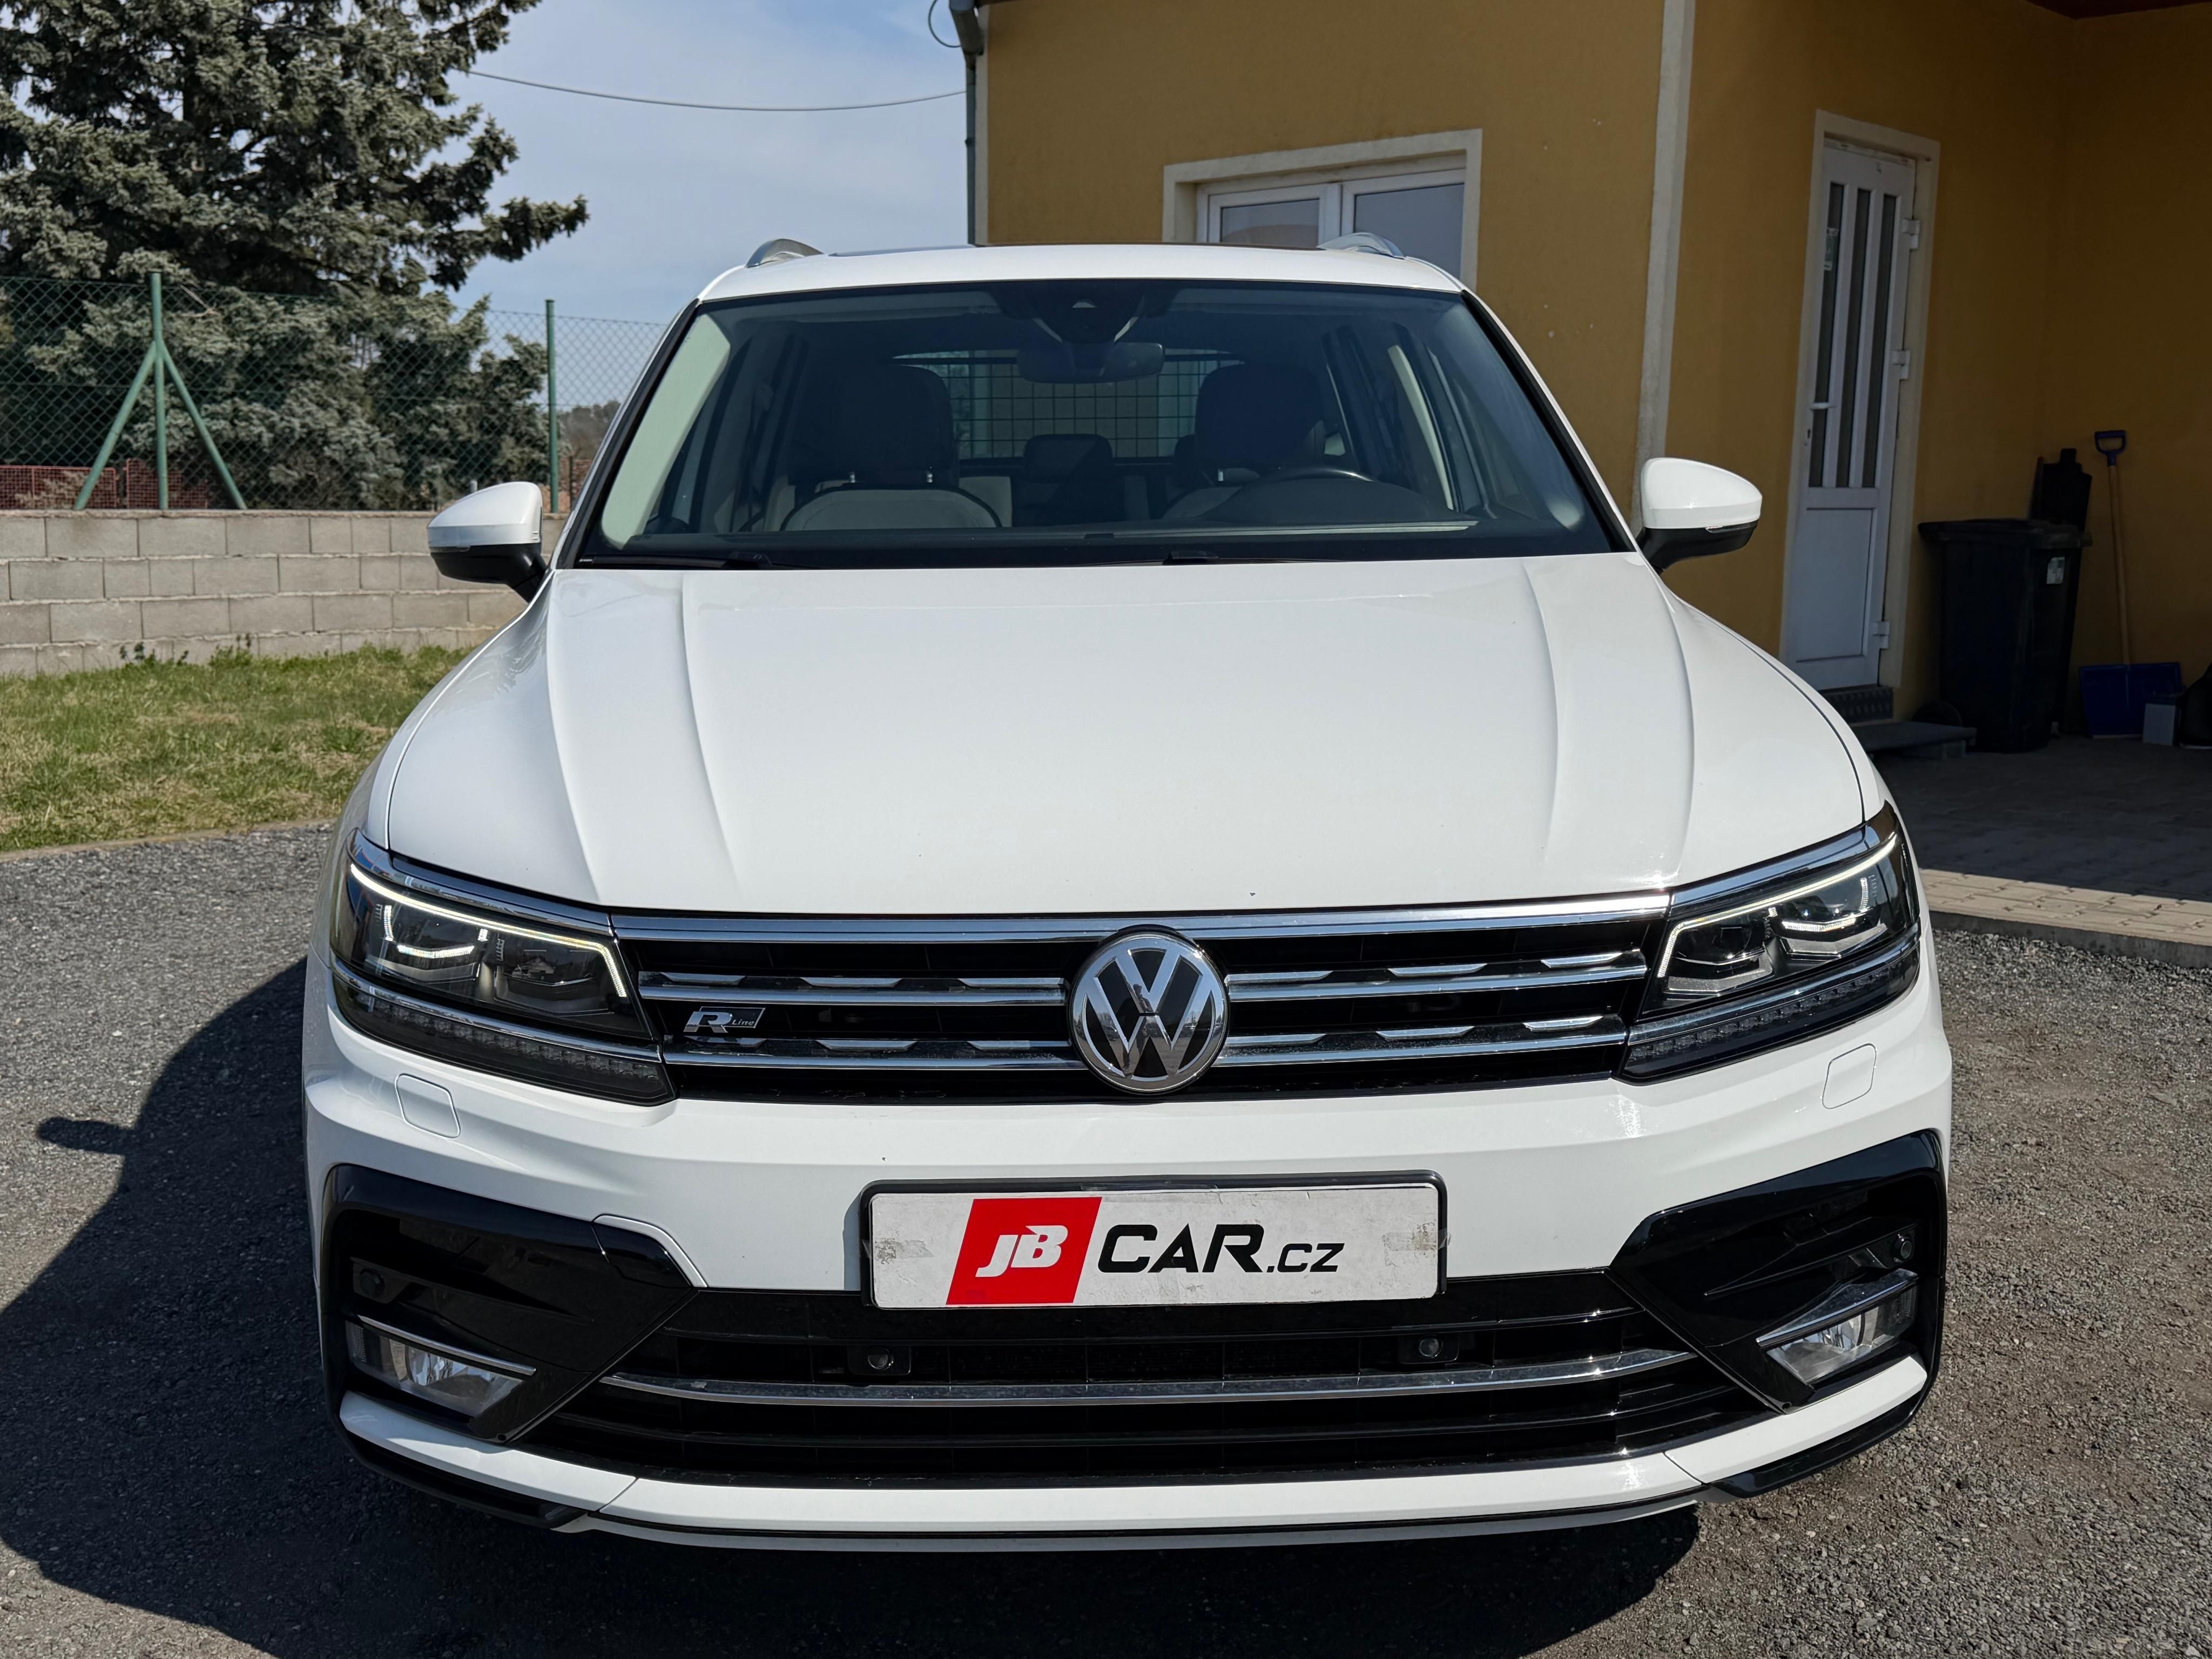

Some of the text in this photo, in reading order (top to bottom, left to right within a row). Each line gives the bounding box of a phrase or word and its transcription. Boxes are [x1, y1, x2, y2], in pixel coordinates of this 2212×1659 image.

[683, 1011, 732, 1033] R
[1076, 936, 1222, 1088] VW
[975, 1225, 1068, 1277] JB
